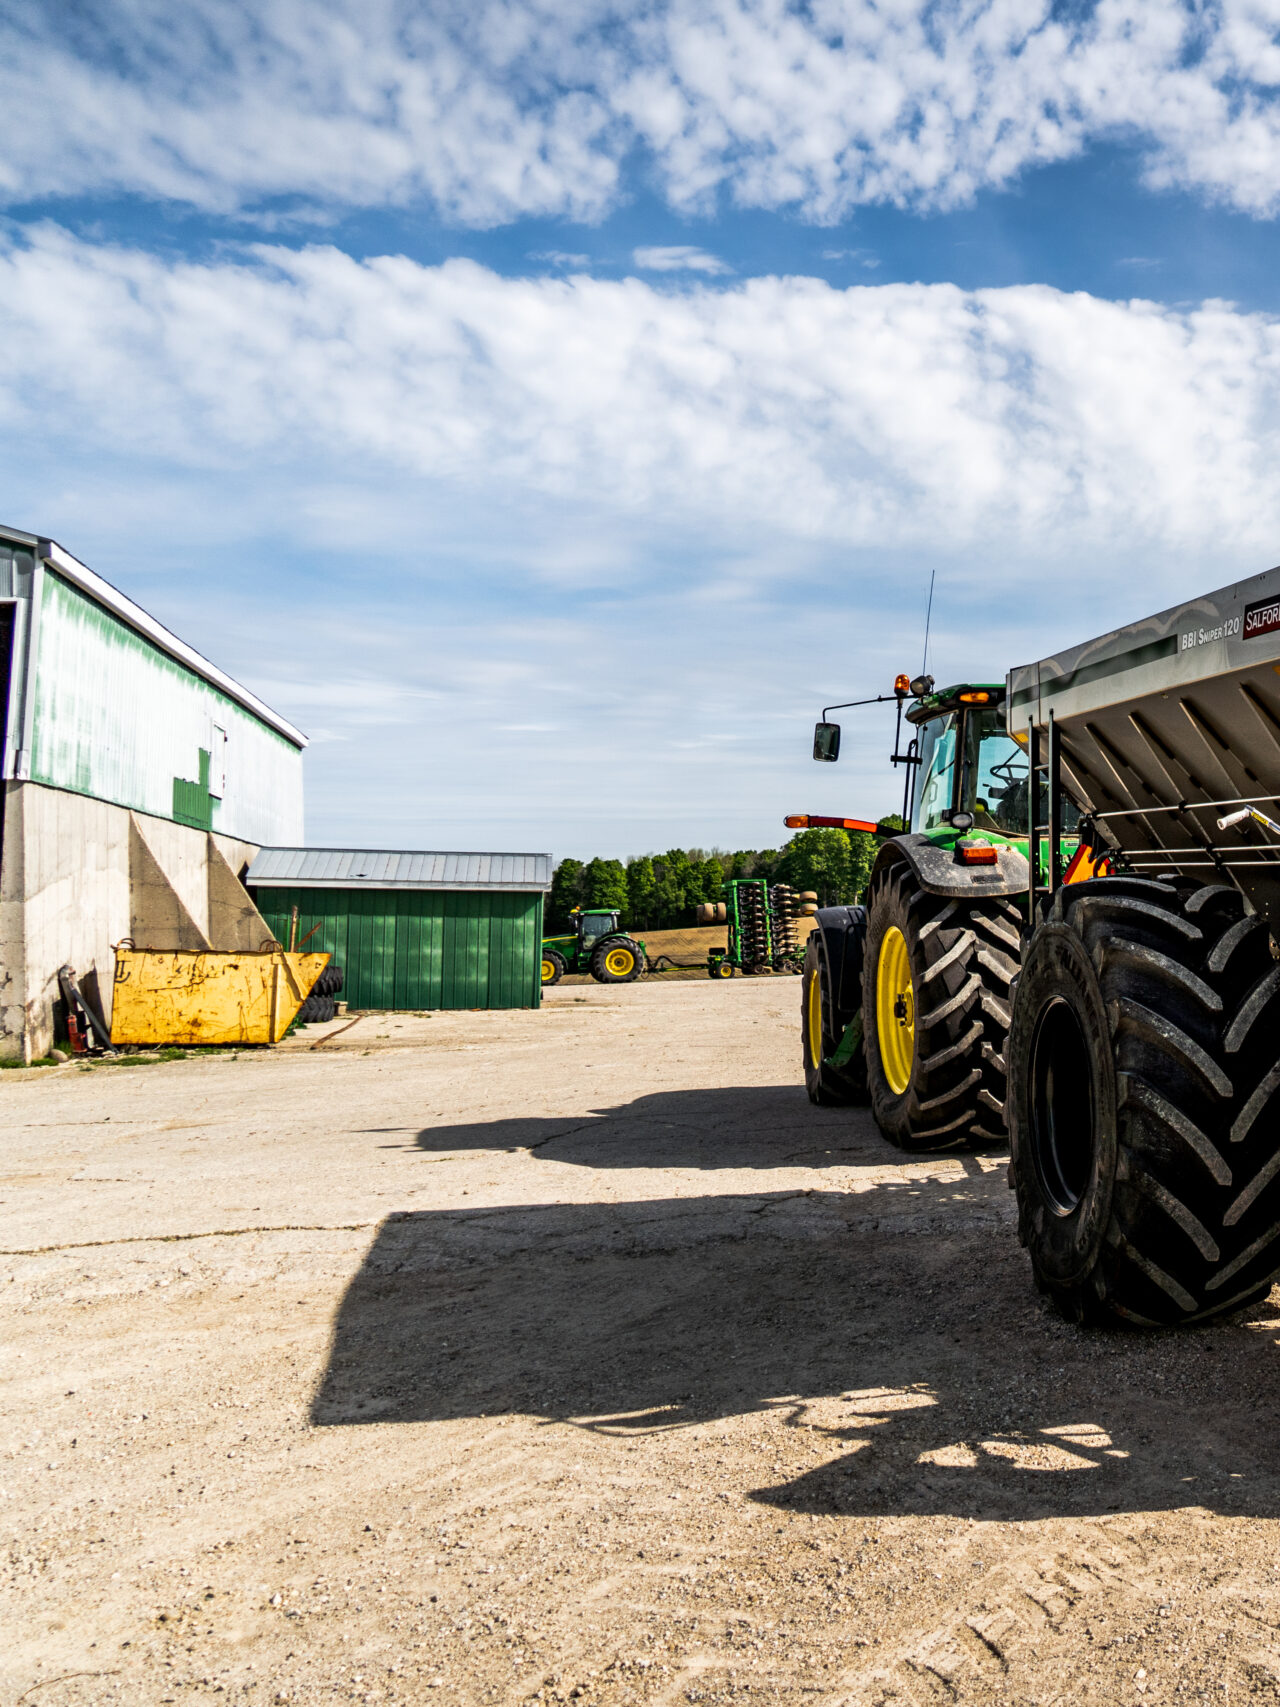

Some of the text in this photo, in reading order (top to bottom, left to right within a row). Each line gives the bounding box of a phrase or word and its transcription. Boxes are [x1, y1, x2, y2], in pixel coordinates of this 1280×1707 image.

[1181, 616, 1240, 651] BBI SNIPER 120
